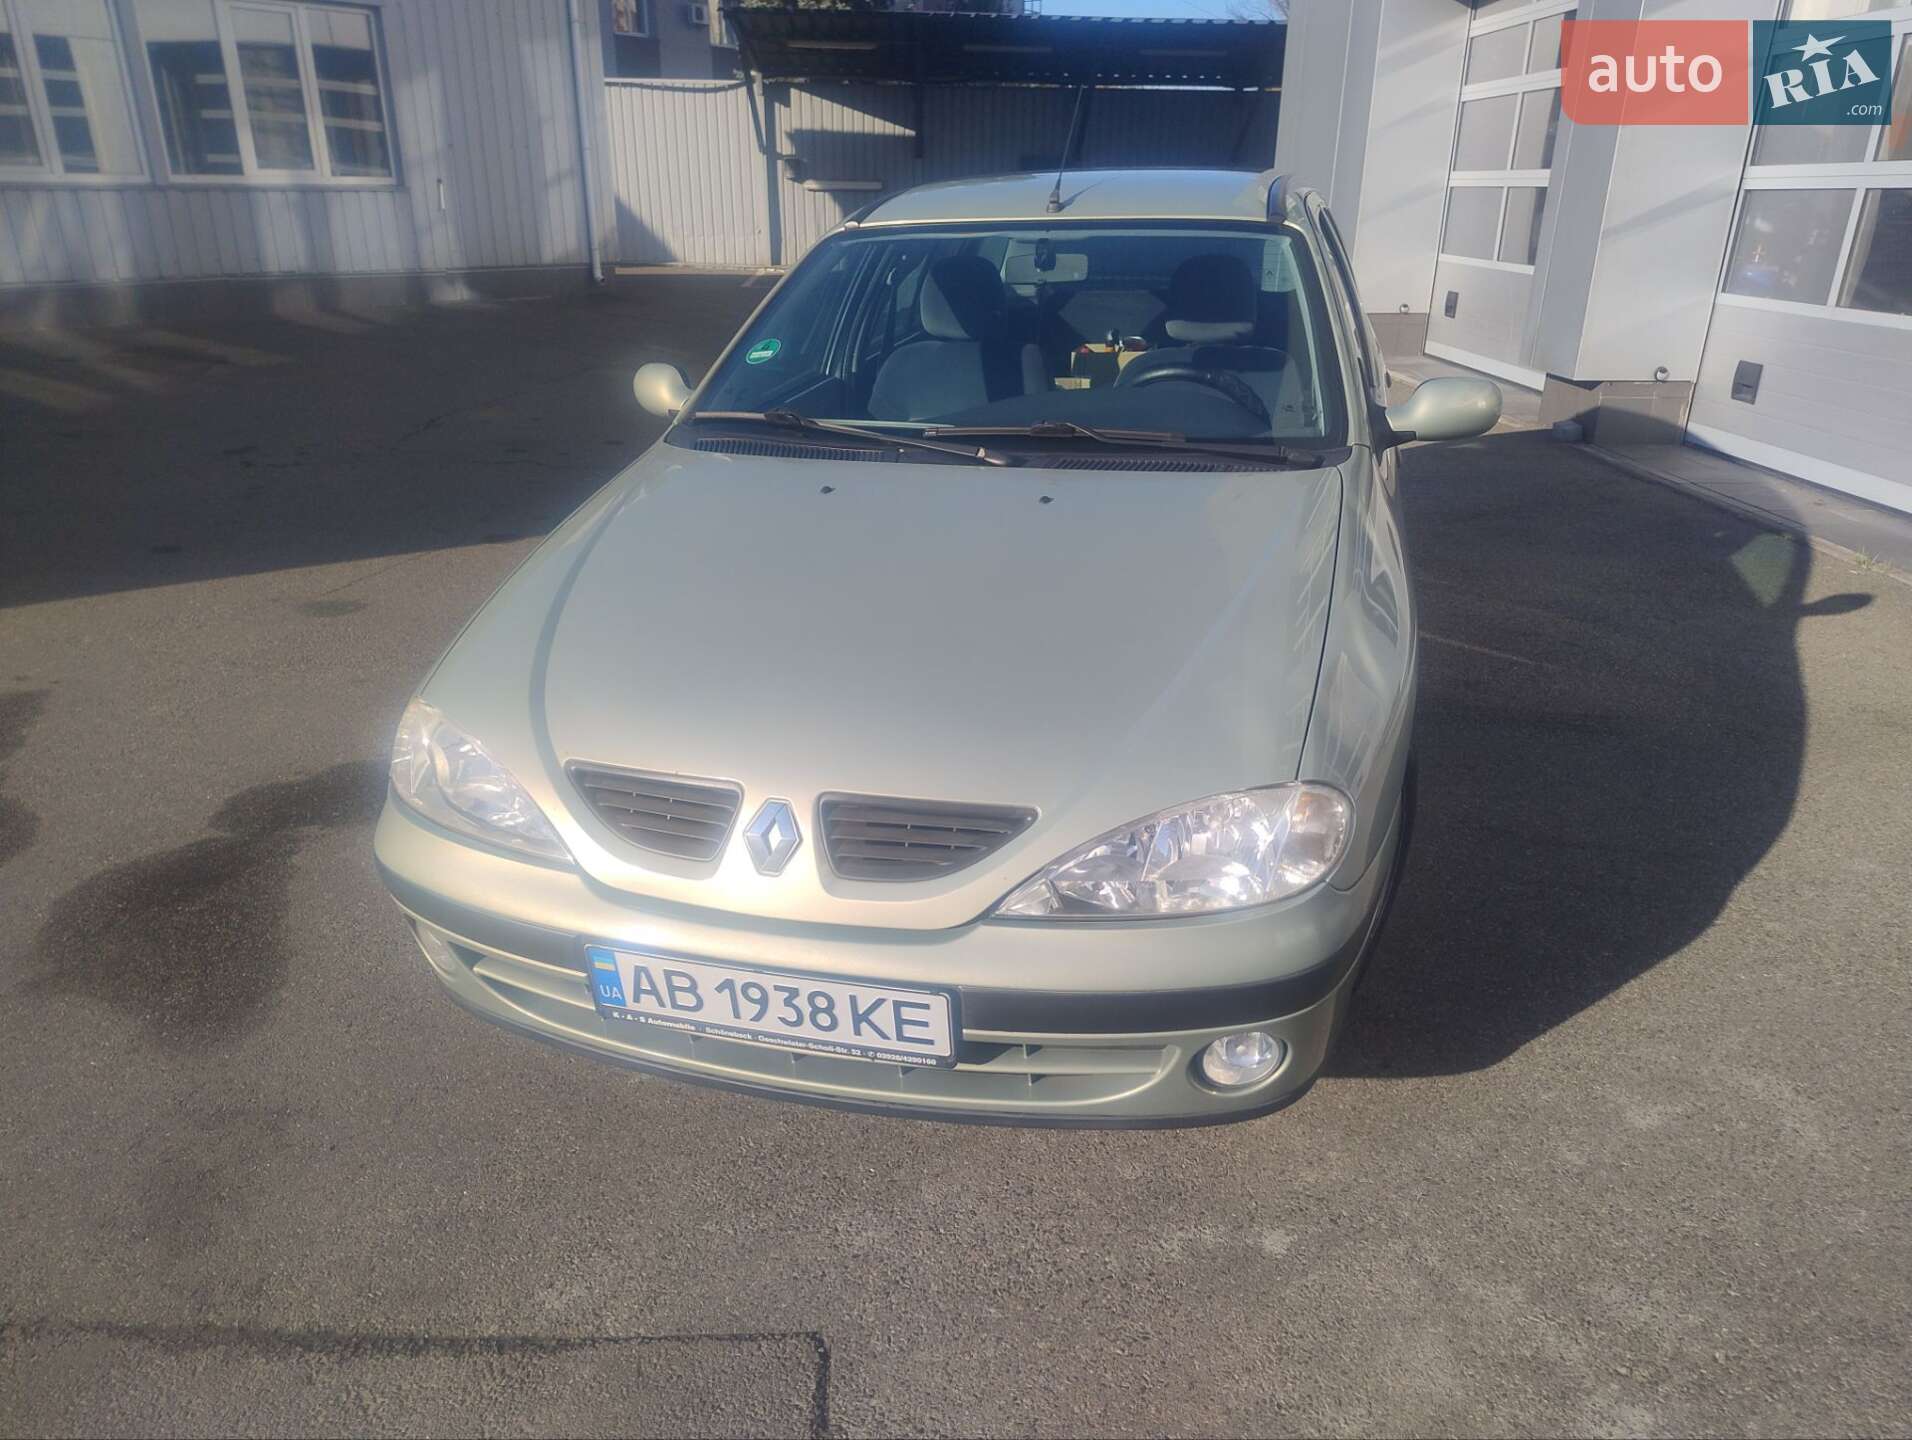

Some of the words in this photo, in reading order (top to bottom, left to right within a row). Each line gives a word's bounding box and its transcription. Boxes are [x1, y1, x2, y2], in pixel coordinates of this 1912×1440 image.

[600, 984, 622, 1000] UA
[632, 965, 704, 1012] AB
[714, 978, 839, 1033] 1938
[848, 994, 935, 1046] KE
